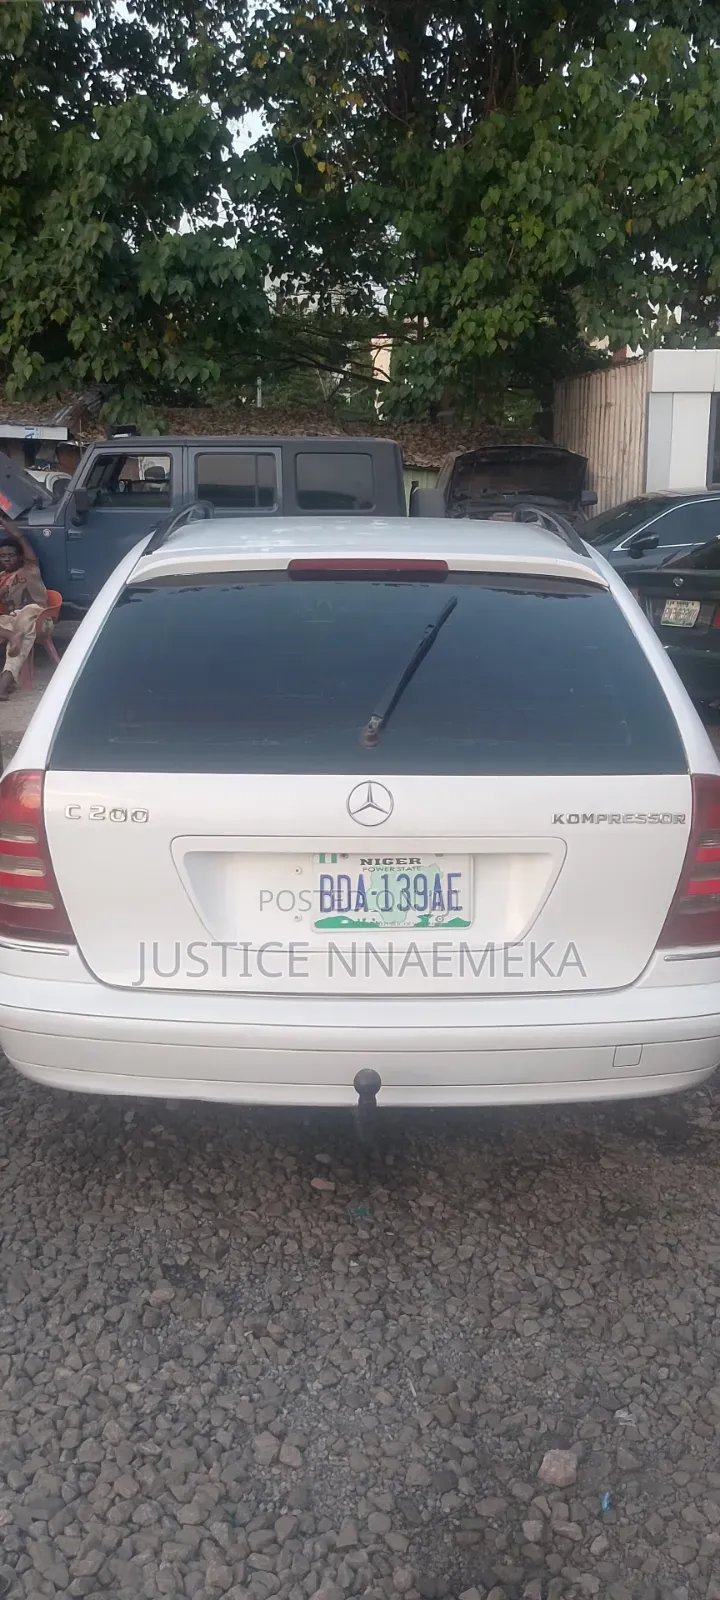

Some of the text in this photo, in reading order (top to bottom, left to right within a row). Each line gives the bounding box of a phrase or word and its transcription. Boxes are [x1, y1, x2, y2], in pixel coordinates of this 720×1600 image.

[64, 803, 149, 824] C 200
[552, 812, 686, 825] KOMPRESSOR
[359, 857, 422, 866] NIGER
